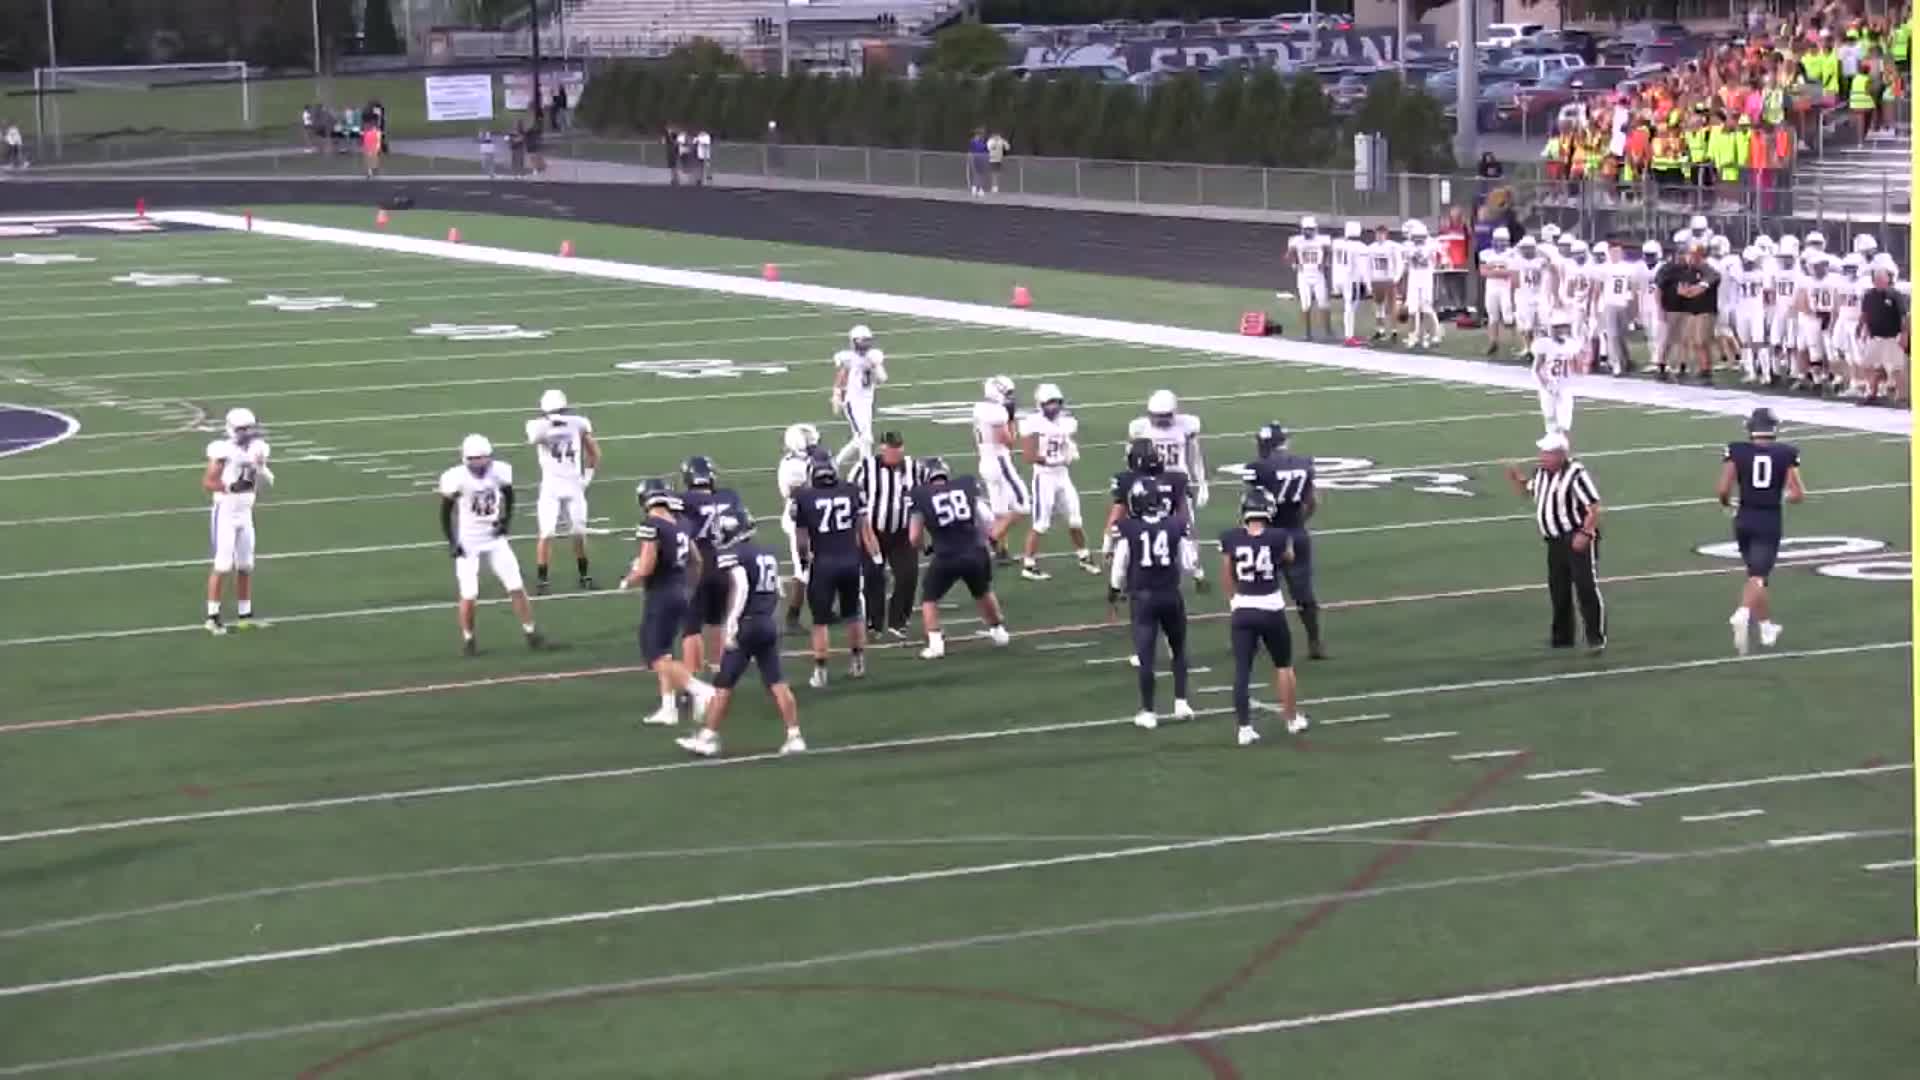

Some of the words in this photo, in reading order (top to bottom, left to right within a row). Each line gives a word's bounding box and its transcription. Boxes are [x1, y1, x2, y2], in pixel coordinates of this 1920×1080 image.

[552, 440, 576, 464] 44
[1275, 469, 1307, 503] 77
[1752, 455, 1771, 488] 0
[815, 497, 852, 532] 72
[932, 489, 971, 527] 58
[1140, 529, 1170, 567] 14
[1236, 545, 1274, 582] 24
